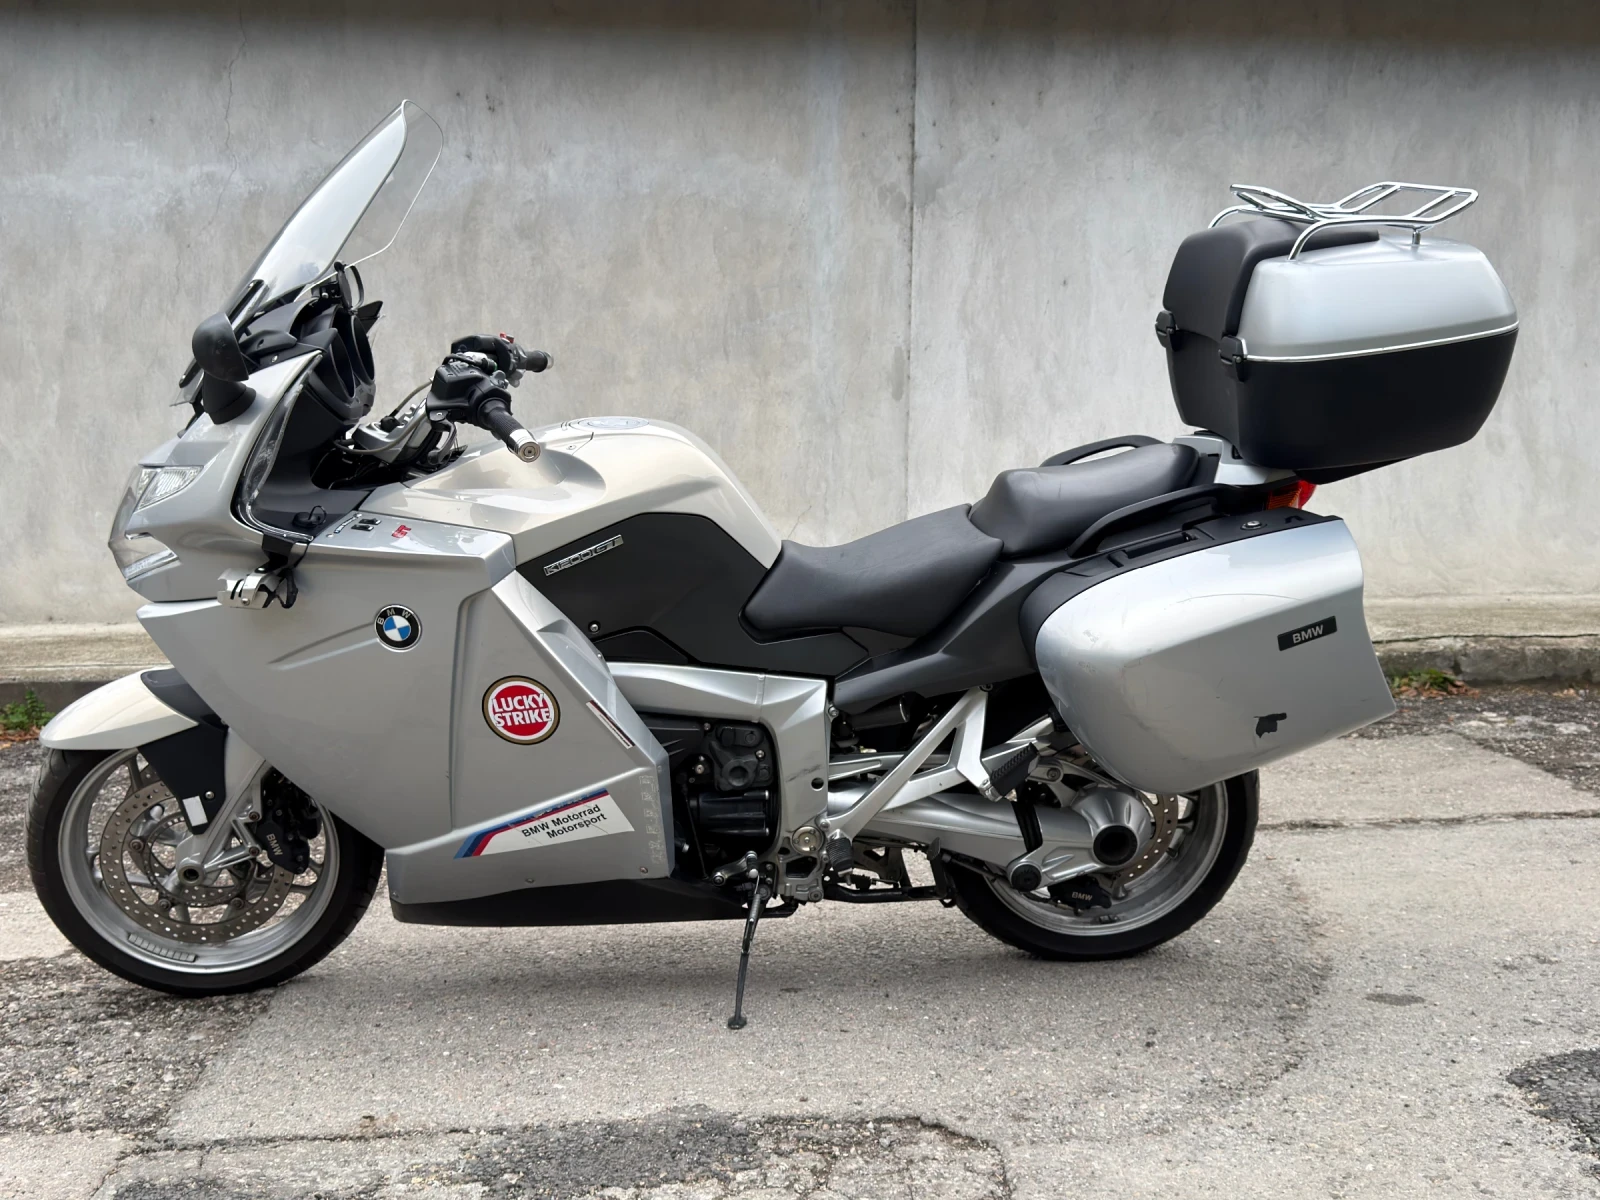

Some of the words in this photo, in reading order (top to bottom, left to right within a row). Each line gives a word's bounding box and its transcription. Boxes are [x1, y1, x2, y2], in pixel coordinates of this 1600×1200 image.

[377, 608, 411, 625] BMW
[1292, 624, 1324, 644] BMW
[491, 693, 545, 713] LUCKY
[494, 708, 552, 727] STRIKE
[521, 821, 550, 838] BMW
[550, 804, 602, 828] Motorrad
[546, 813, 608, 839] Motorsport
[266, 833, 283, 856] BMW
[1071, 891, 1093, 901] BMW
